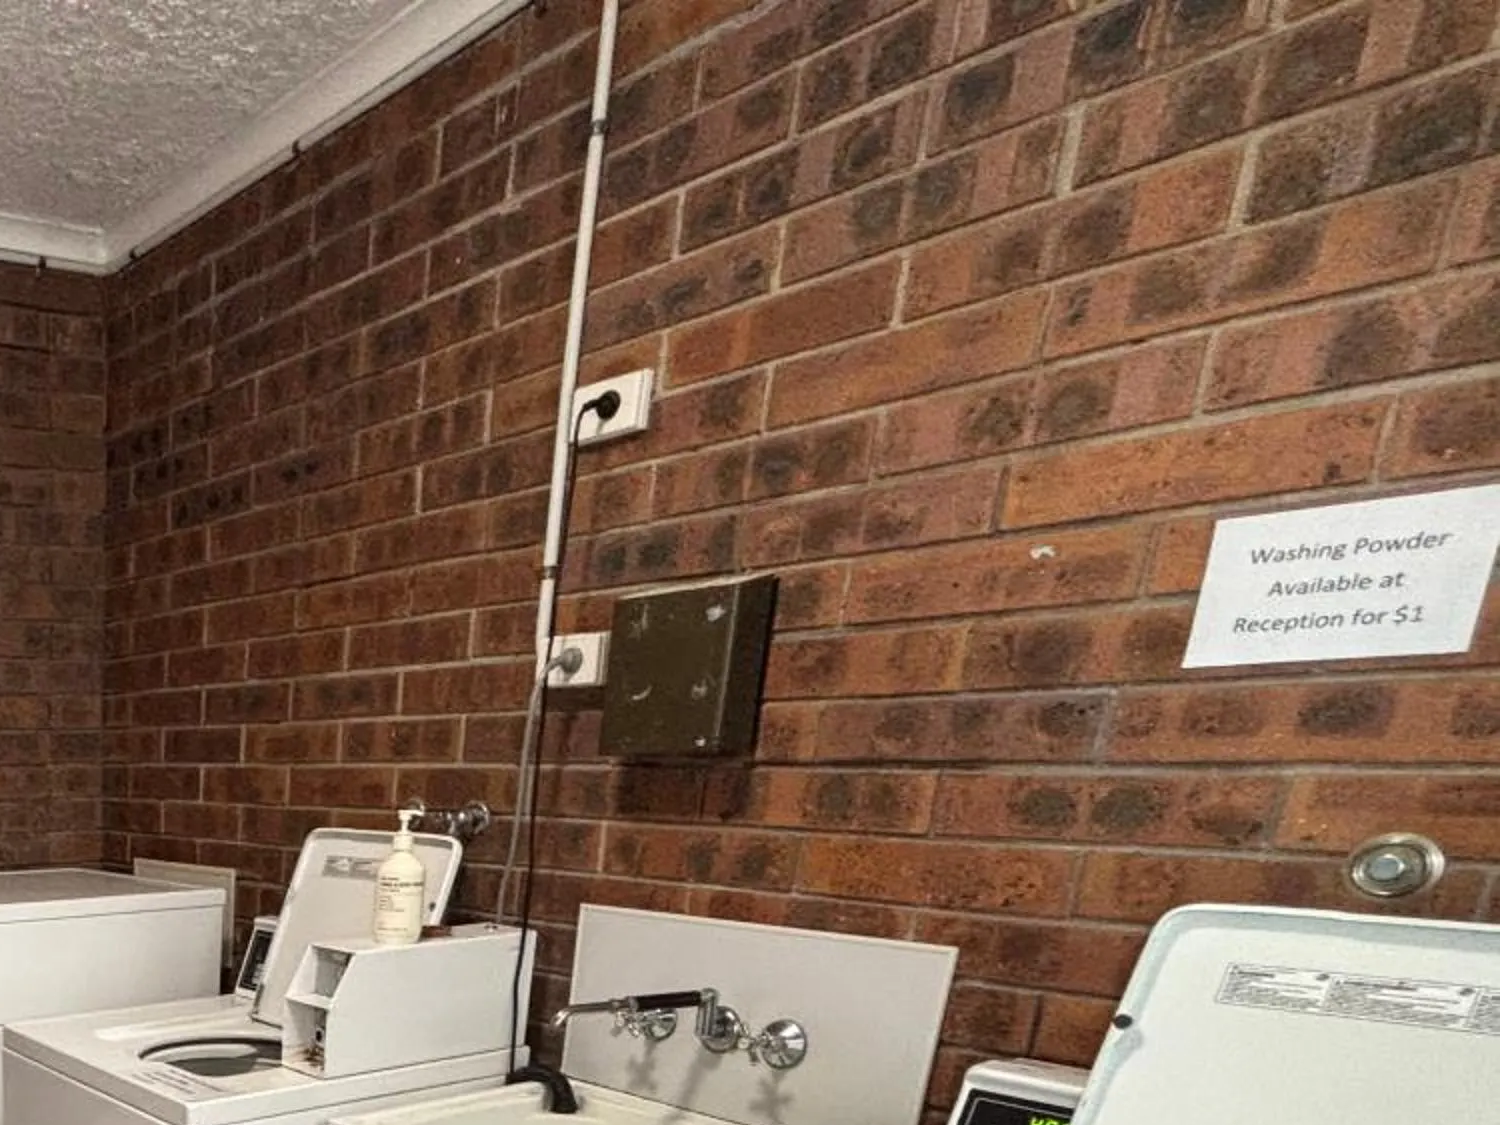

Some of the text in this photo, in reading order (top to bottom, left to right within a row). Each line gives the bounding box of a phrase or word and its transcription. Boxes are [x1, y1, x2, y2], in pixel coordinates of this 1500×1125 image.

[1251, 530, 1453, 564] Washing Powder
[1267, 571, 1405, 597] Available at
[1233, 605, 1425, 635] Reception for $1
